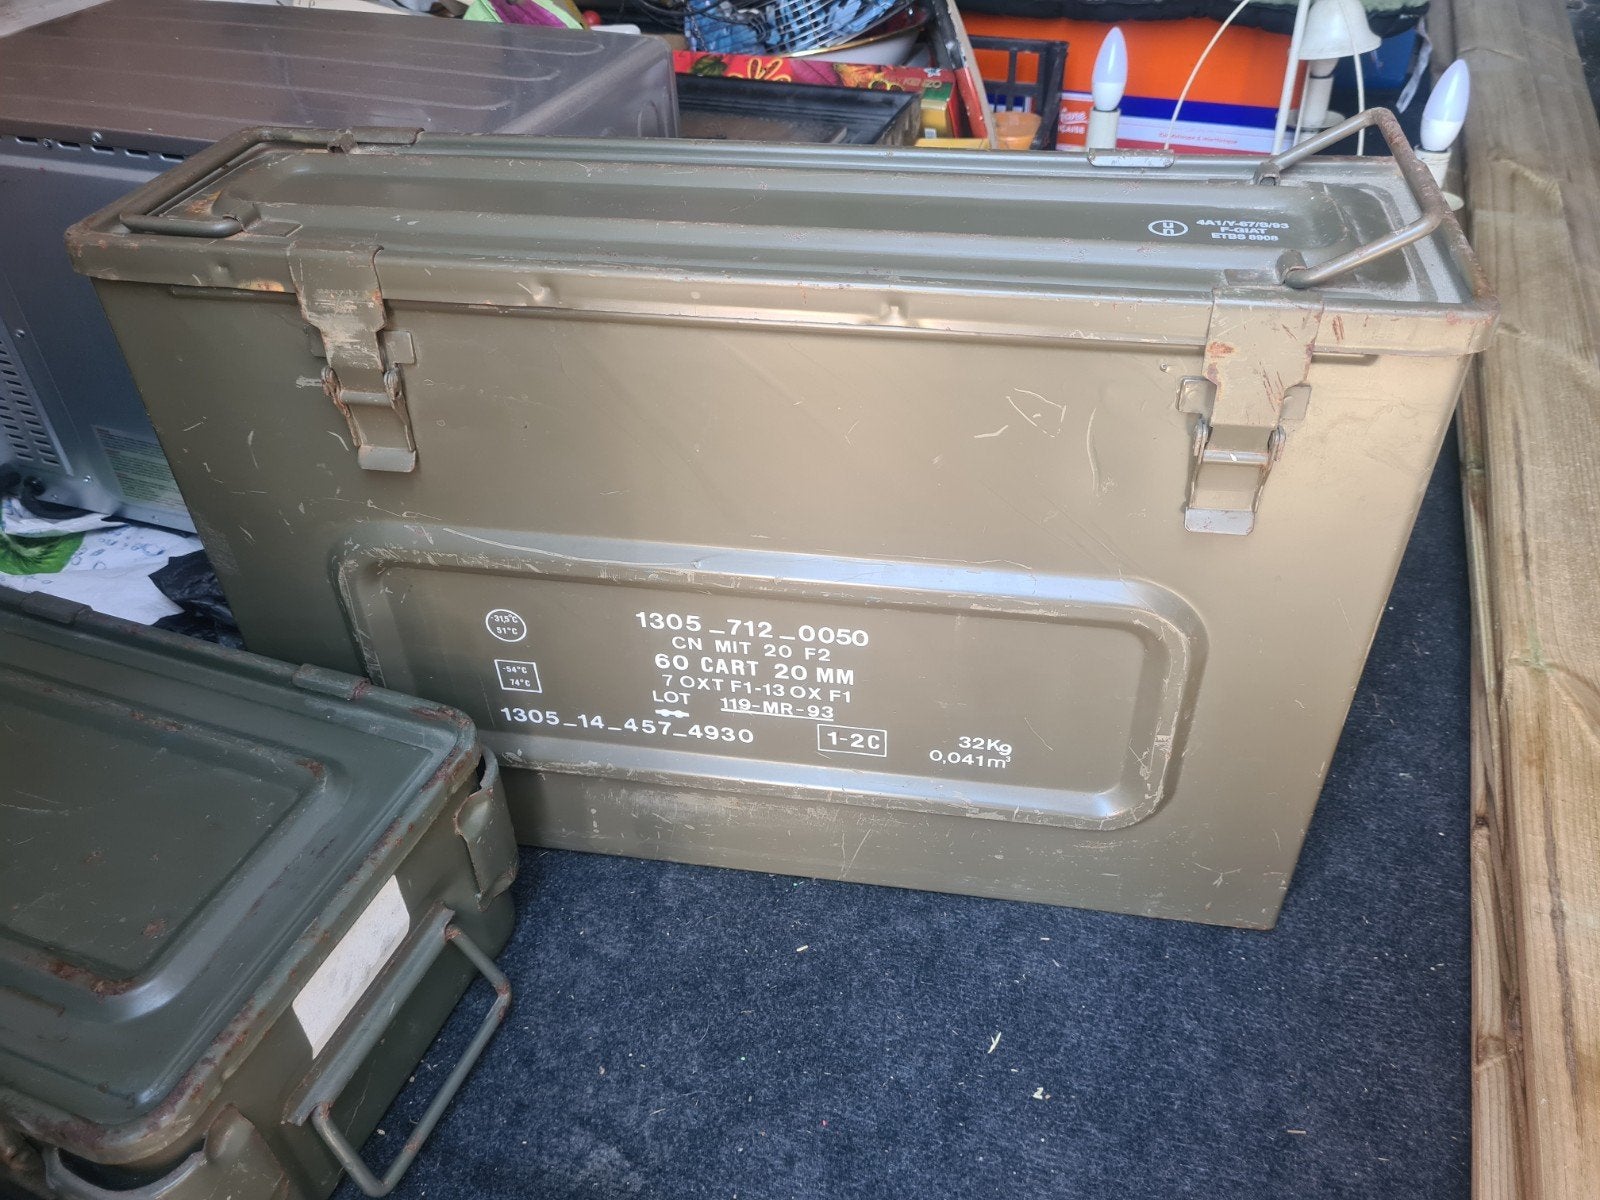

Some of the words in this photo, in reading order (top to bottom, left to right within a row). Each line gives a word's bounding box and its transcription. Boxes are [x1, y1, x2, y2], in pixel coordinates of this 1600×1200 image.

[671, 636, 703, 650] CN
[714, 639, 752, 655] MIT
[764, 644, 793, 658] 20
[804, 647, 831, 662] F2
[654, 653, 689, 671] 60
[700, 656, 759, 676] CART
[774, 663, 808, 681] 20
[816, 667, 854, 686] MM
[652, 690, 691, 705] LOT
[720, 697, 834, 719] 119-MR-93
[829, 689, 851, 704] F1
[826, 731, 880, 750] 1-2C
